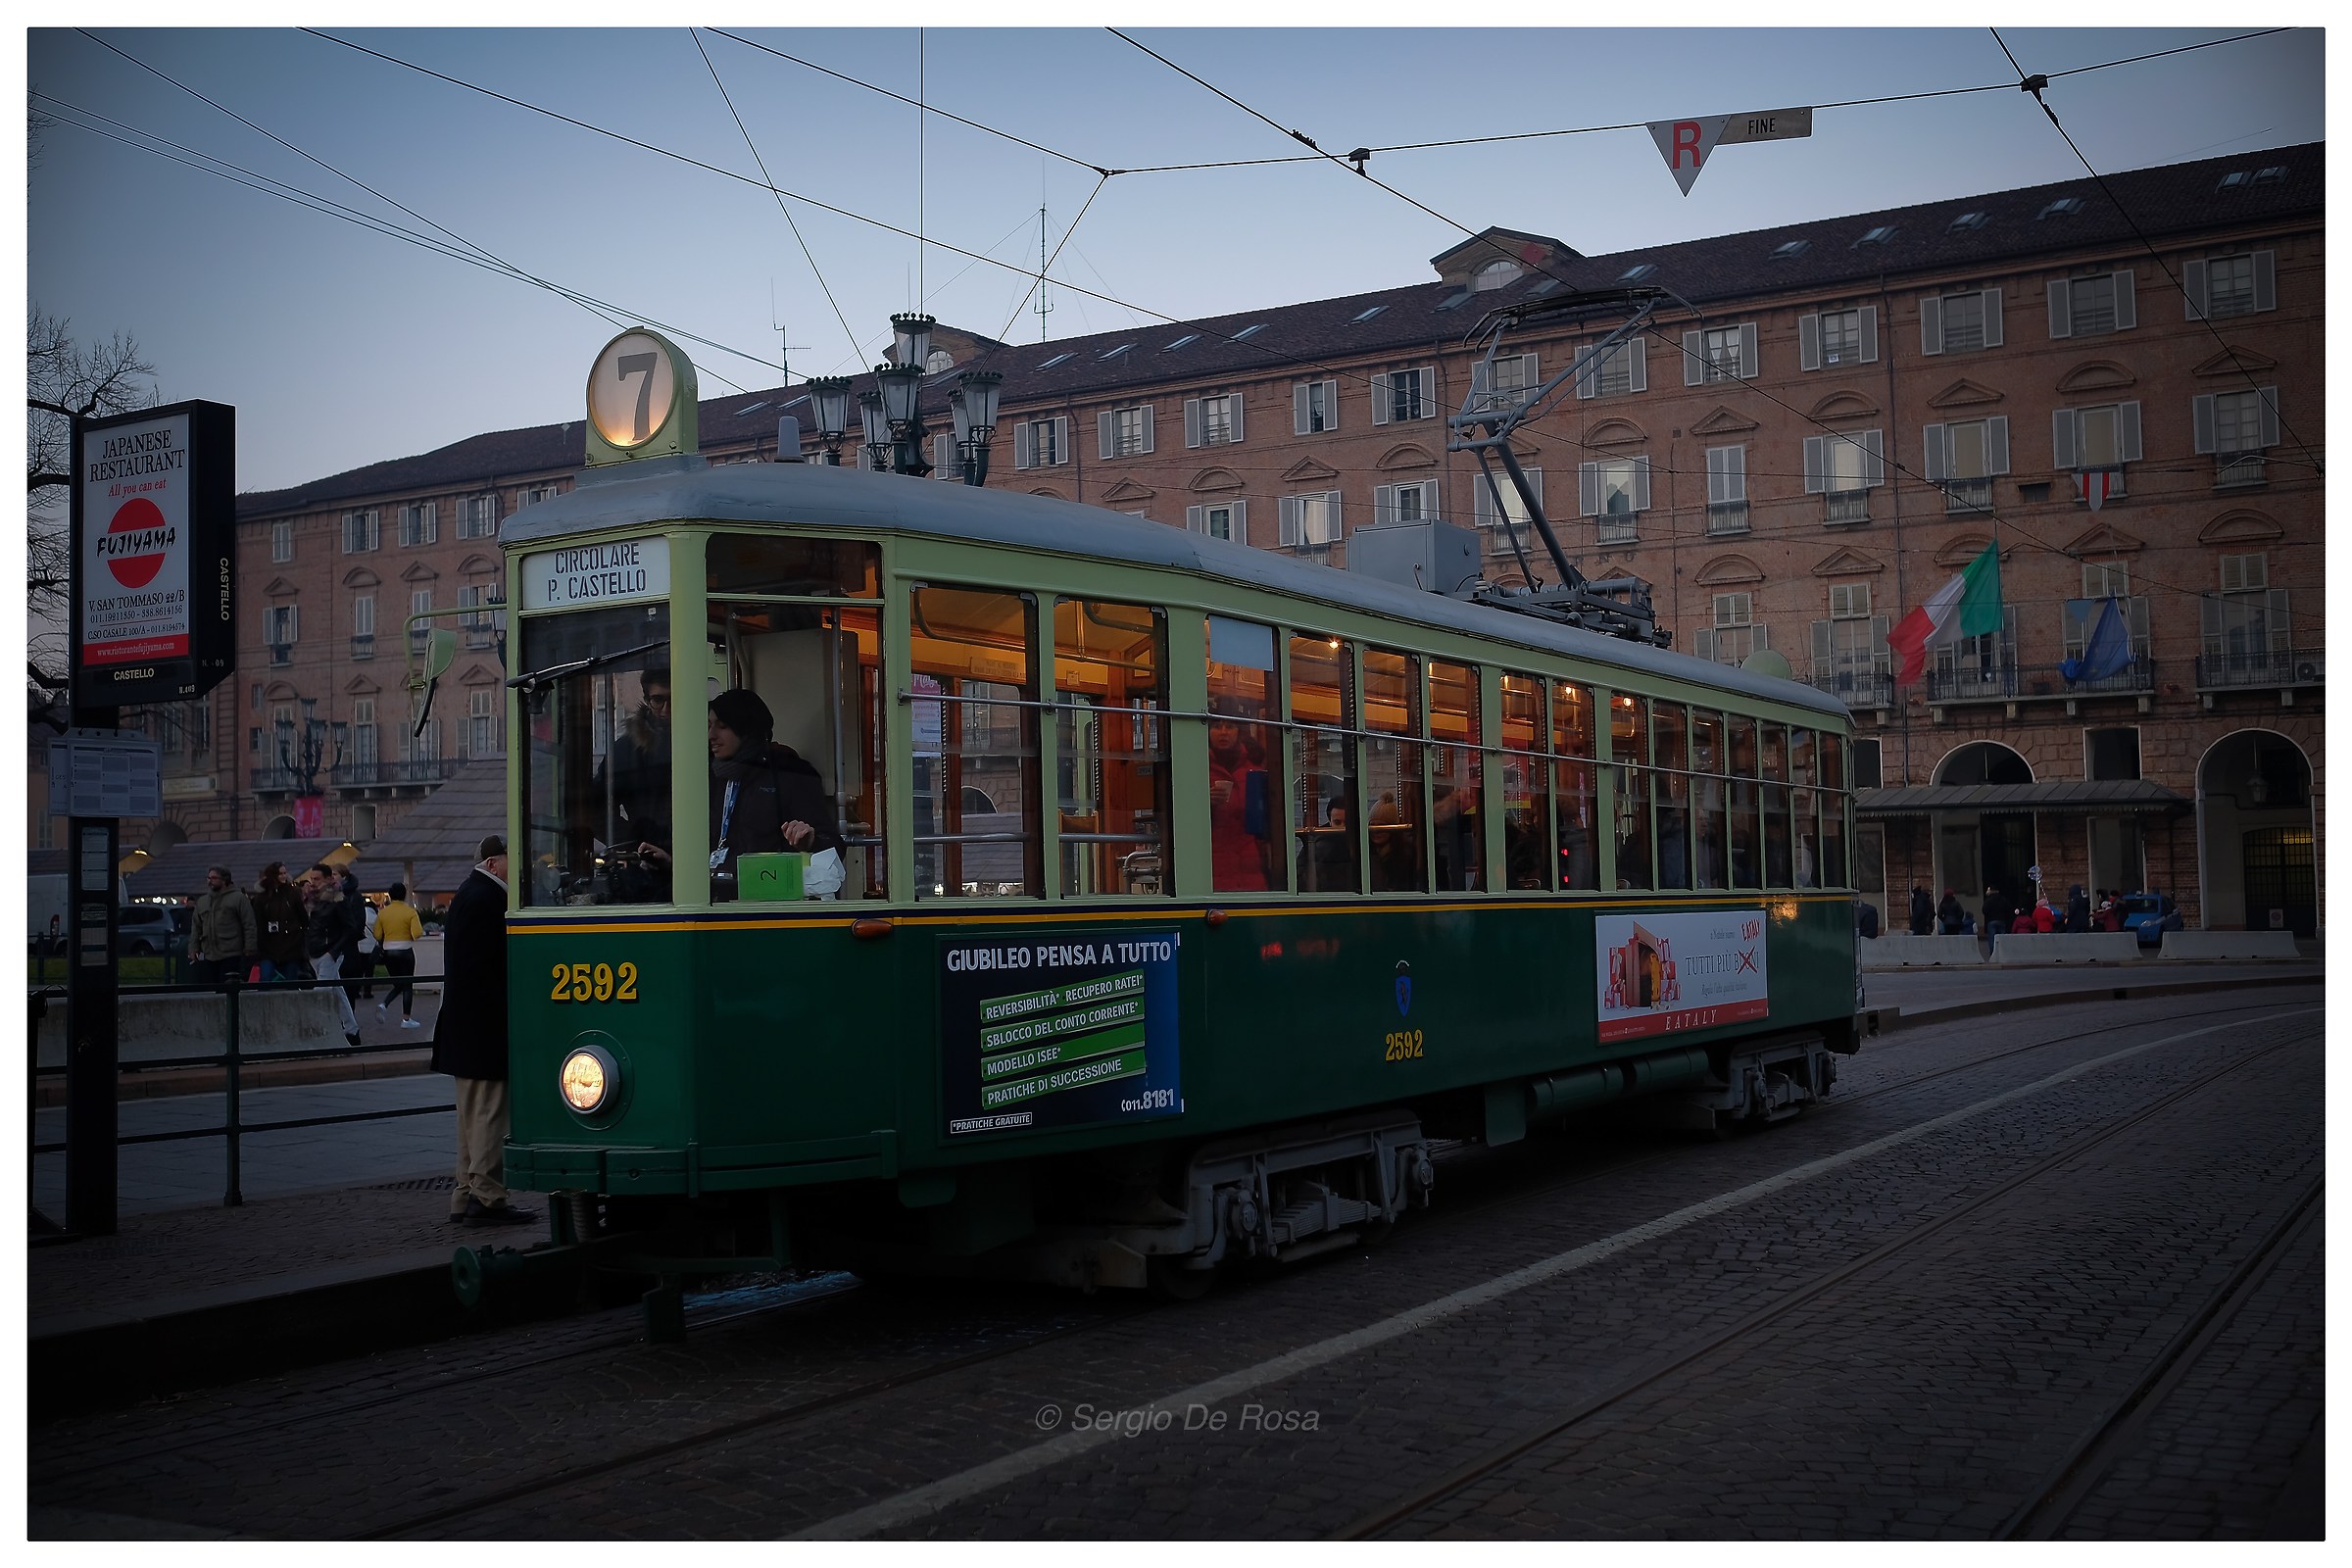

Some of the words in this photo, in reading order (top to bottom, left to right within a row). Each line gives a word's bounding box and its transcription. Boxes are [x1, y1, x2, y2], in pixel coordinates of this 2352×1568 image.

[1747, 117, 1776, 135] FINE
[1672, 121, 1702, 170] R
[617, 351, 659, 444] 7
[102, 429, 172, 460] JAPANESE
[89, 449, 185, 483] RESTAURANT
[108, 483, 122, 497] All
[122, 485, 137, 499] you
[138, 481, 153, 492] can
[154, 477, 167, 490] eat
[96, 525, 176, 558] FUJIYAMA
[555, 542, 640, 575] CIRCOLARE
[88, 600, 96, 612] V.
[97, 598, 115, 612] SAN
[116, 592, 164, 610] TOMMASO
[165, 589, 185, 604] 22/B
[220, 557, 230, 621] CASTELLO
[547, 578, 561, 602] P.
[568, 568, 647, 600] CASTELLO
[102, 627, 127, 639] CASALE
[96, 642, 175, 657] www.ristorantefujiyama.com
[113, 667, 155, 681] CASTELLO
[947, 946, 1031, 972] GIUBILEO
[1036, 943, 1098, 968] PENSA
[1101, 943, 1115, 964] A
[1117, 941, 1172, 963] TUTTO
[1685, 955, 1715, 976] TUTTI
[1717, 949, 1732, 973] PIÙ
[550, 961, 640, 1003] 2592
[1064, 980, 1113, 1004] RECUPERO
[986, 1025, 1033, 1049] SBLOCCO
[1034, 1021, 1054, 1037] DEL
[1054, 1012, 1087, 1033] CONTO
[1665, 1009, 1717, 1031] EATALY
[1384, 1028, 1424, 1062] 2592
[986, 1054, 1035, 1077] MODELLO
[986, 1084, 1036, 1106] PRATICHE
[1037, 1077, 1049, 1092] DI
[1050, 1058, 1122, 1089] SUCCESSIONE
[995, 1113, 1031, 1127] GRATUITE
